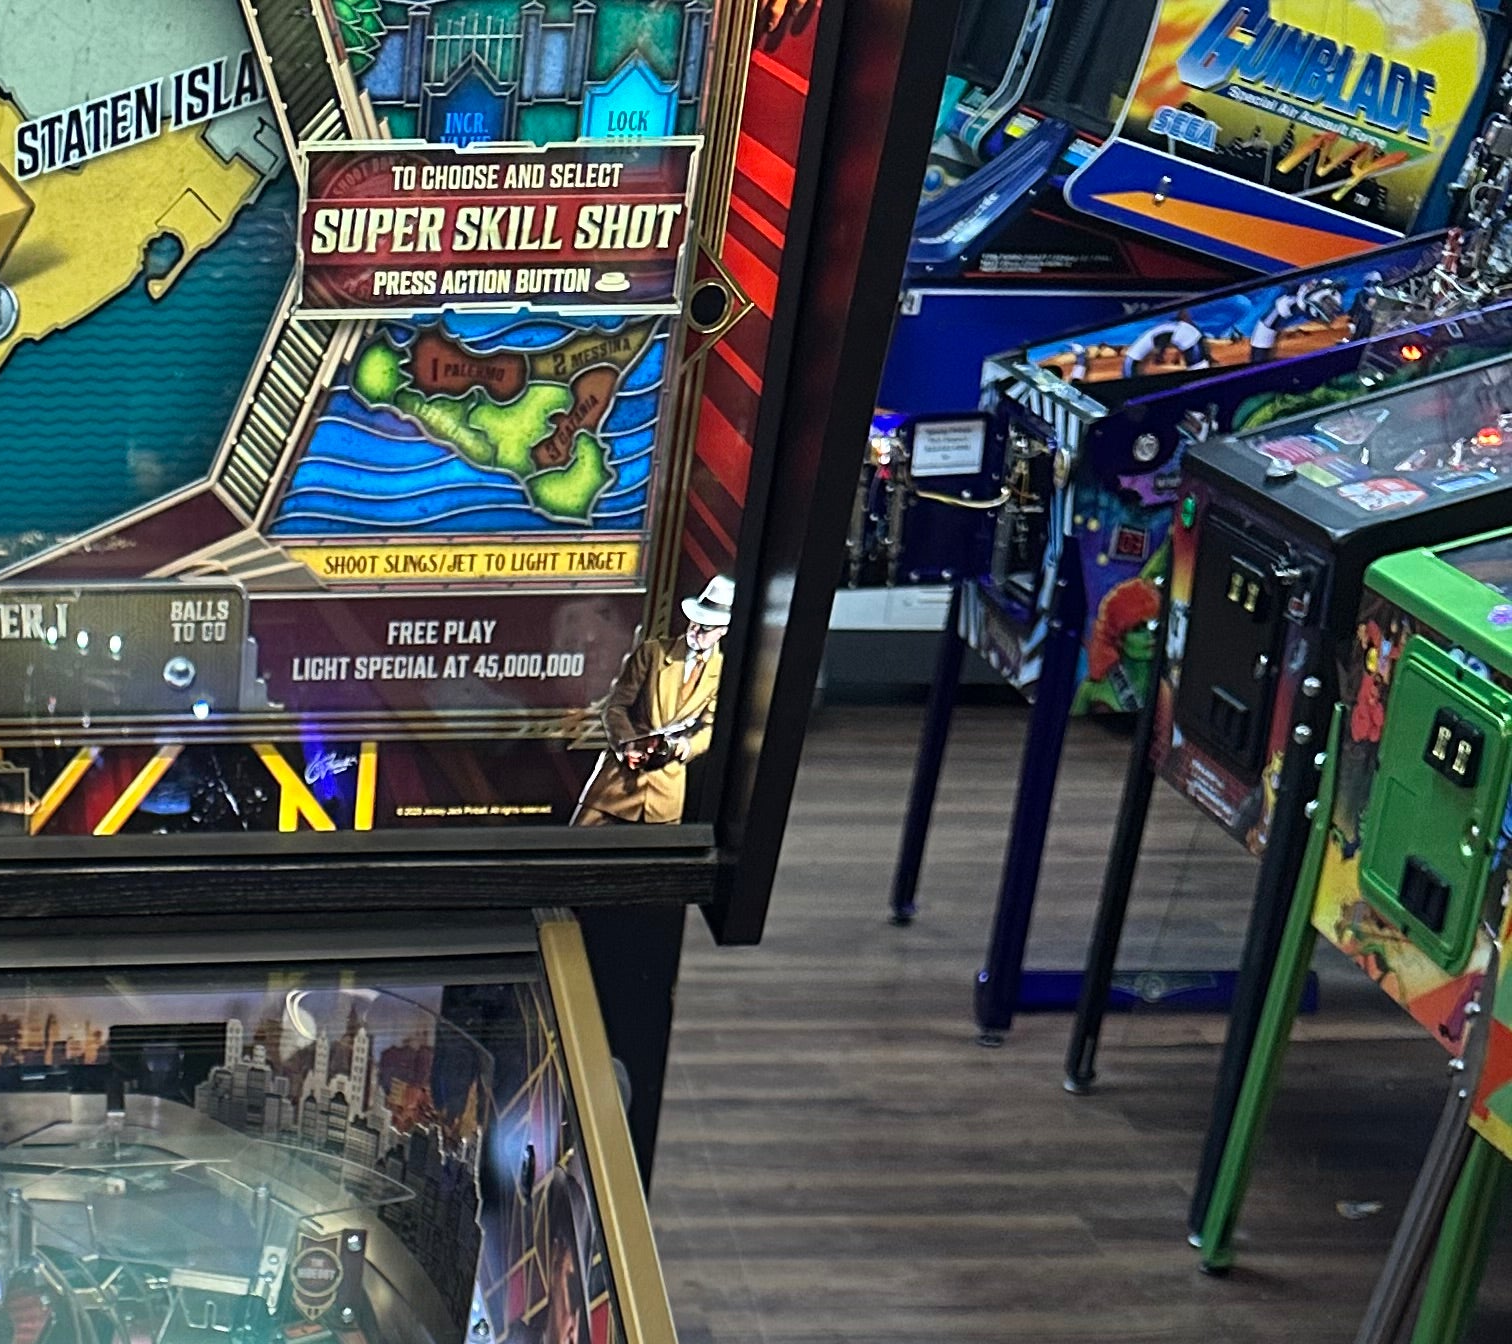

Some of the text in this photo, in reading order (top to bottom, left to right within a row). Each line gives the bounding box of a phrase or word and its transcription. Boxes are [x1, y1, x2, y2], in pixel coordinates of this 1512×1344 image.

[1177, 0, 1437, 144] GUNBLADE
[17, 80, 160, 179] STATEN
[445, 111, 489, 135] INCR.
[608, 110, 651, 132] LOCK
[1150, 105, 1218, 152] SEGA
[1226, 84, 1387, 149] Special Air Assault Force
[392, 162, 623, 191] TO CHOOSE AND SELECT
[311, 203, 682, 254] SUPER SKILL SHOT
[373, 268, 590, 296] PRESS ACTION BUTTON
[553, 337, 632, 377] 2 MESSINA
[443, 363, 505, 382] PALERMO
[323, 551, 627, 575] SHOOT SLINGS/JET TO LIGHT TARGET
[170, 601, 230, 621] BALLS
[171, 622, 226, 642] TO GO
[387, 620, 497, 646] FREE PLAY
[292, 653, 585, 682] LIGHT SPECIAL AT 45,000,000
